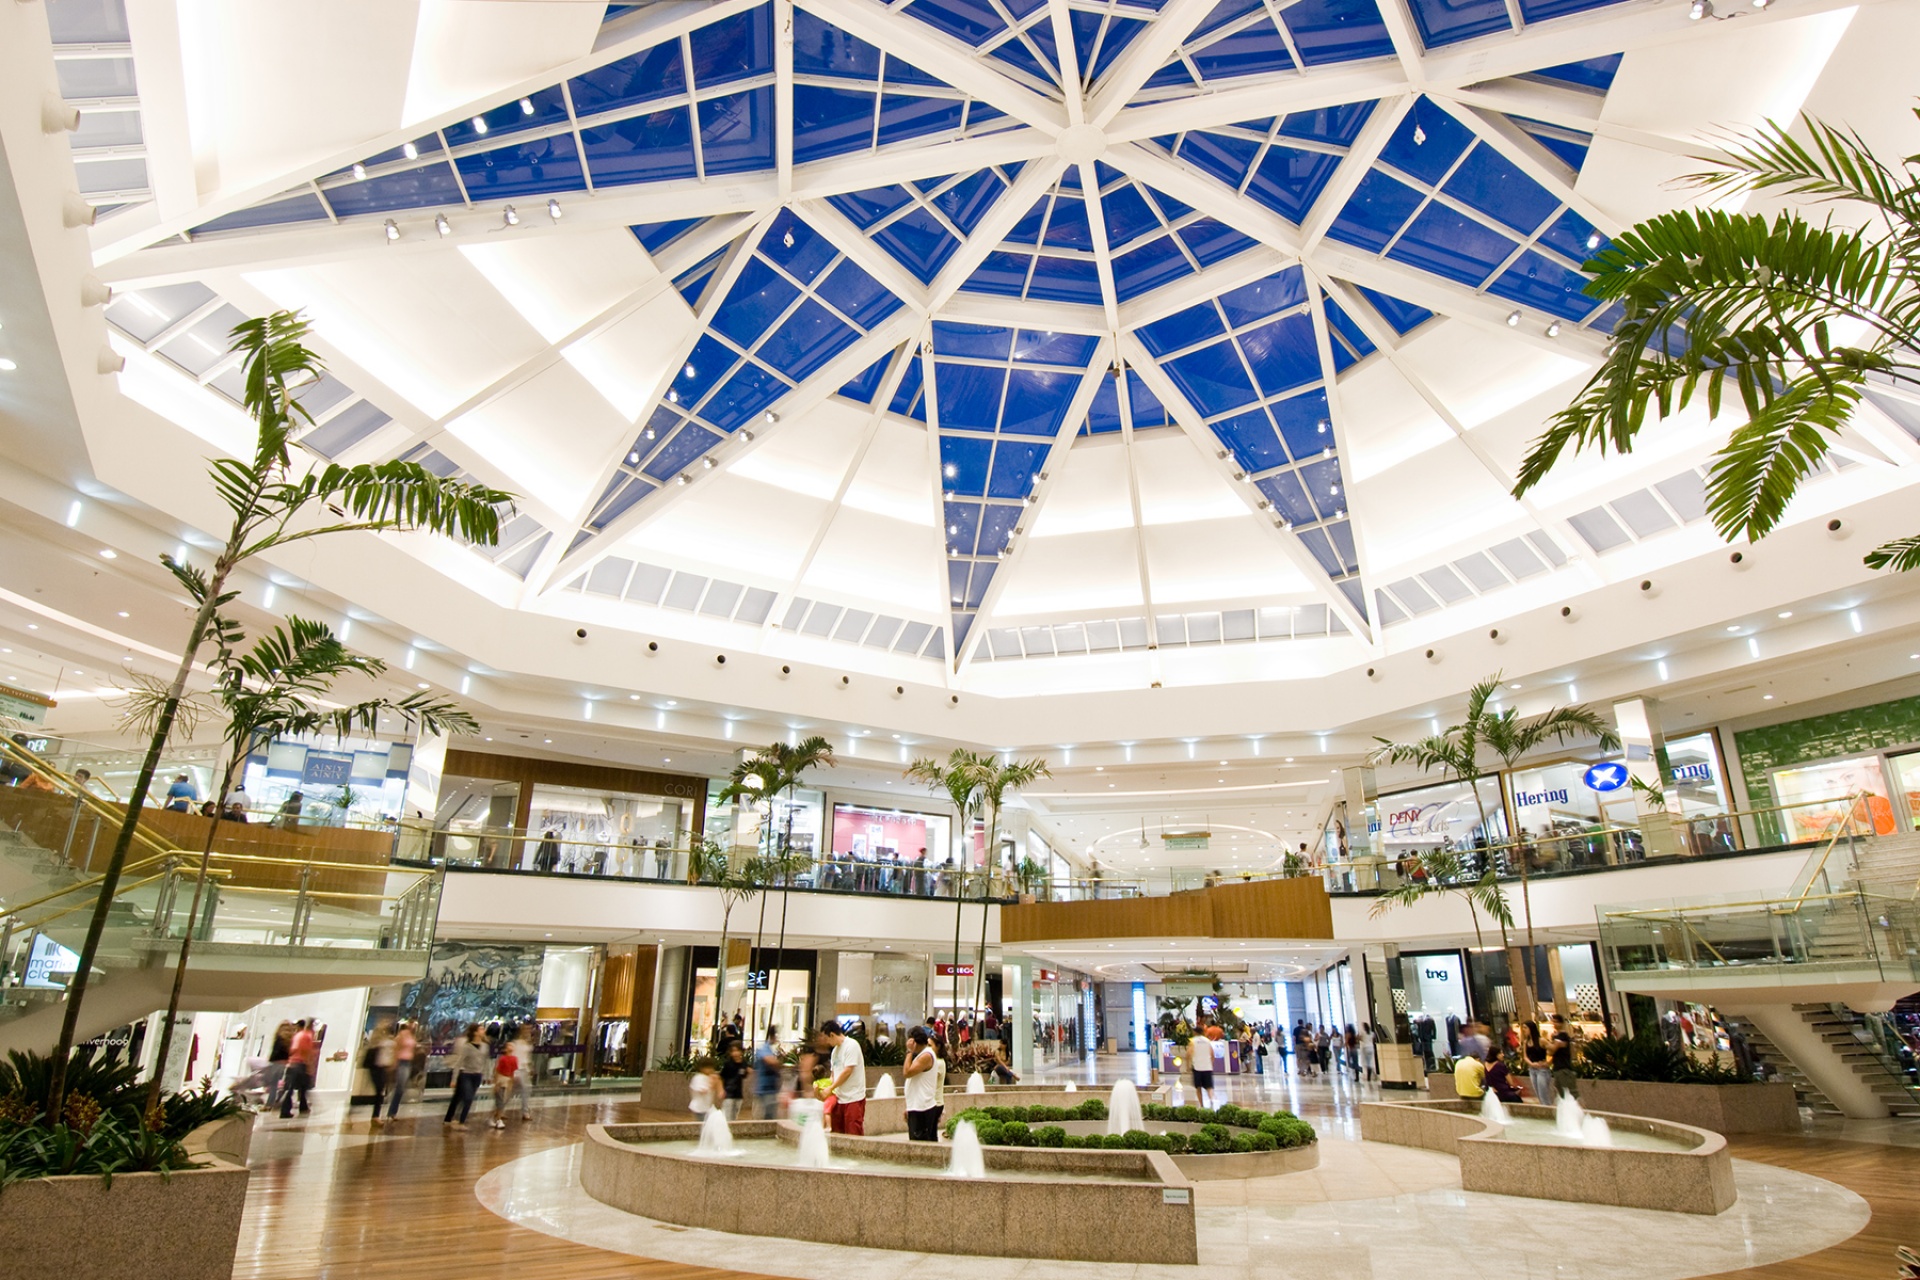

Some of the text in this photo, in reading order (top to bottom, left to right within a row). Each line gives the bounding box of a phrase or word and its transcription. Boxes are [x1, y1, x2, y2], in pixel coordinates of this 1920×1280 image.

[312, 763, 344, 772] ANY
[311, 771, 342, 779] ANY
[664, 783, 698, 797] CORI
[1516, 788, 1569, 808] Hering
[1389, 808, 1421, 826] DENY
[441, 970, 506, 990] ANIMALE
[1425, 968, 1448, 982] tng
